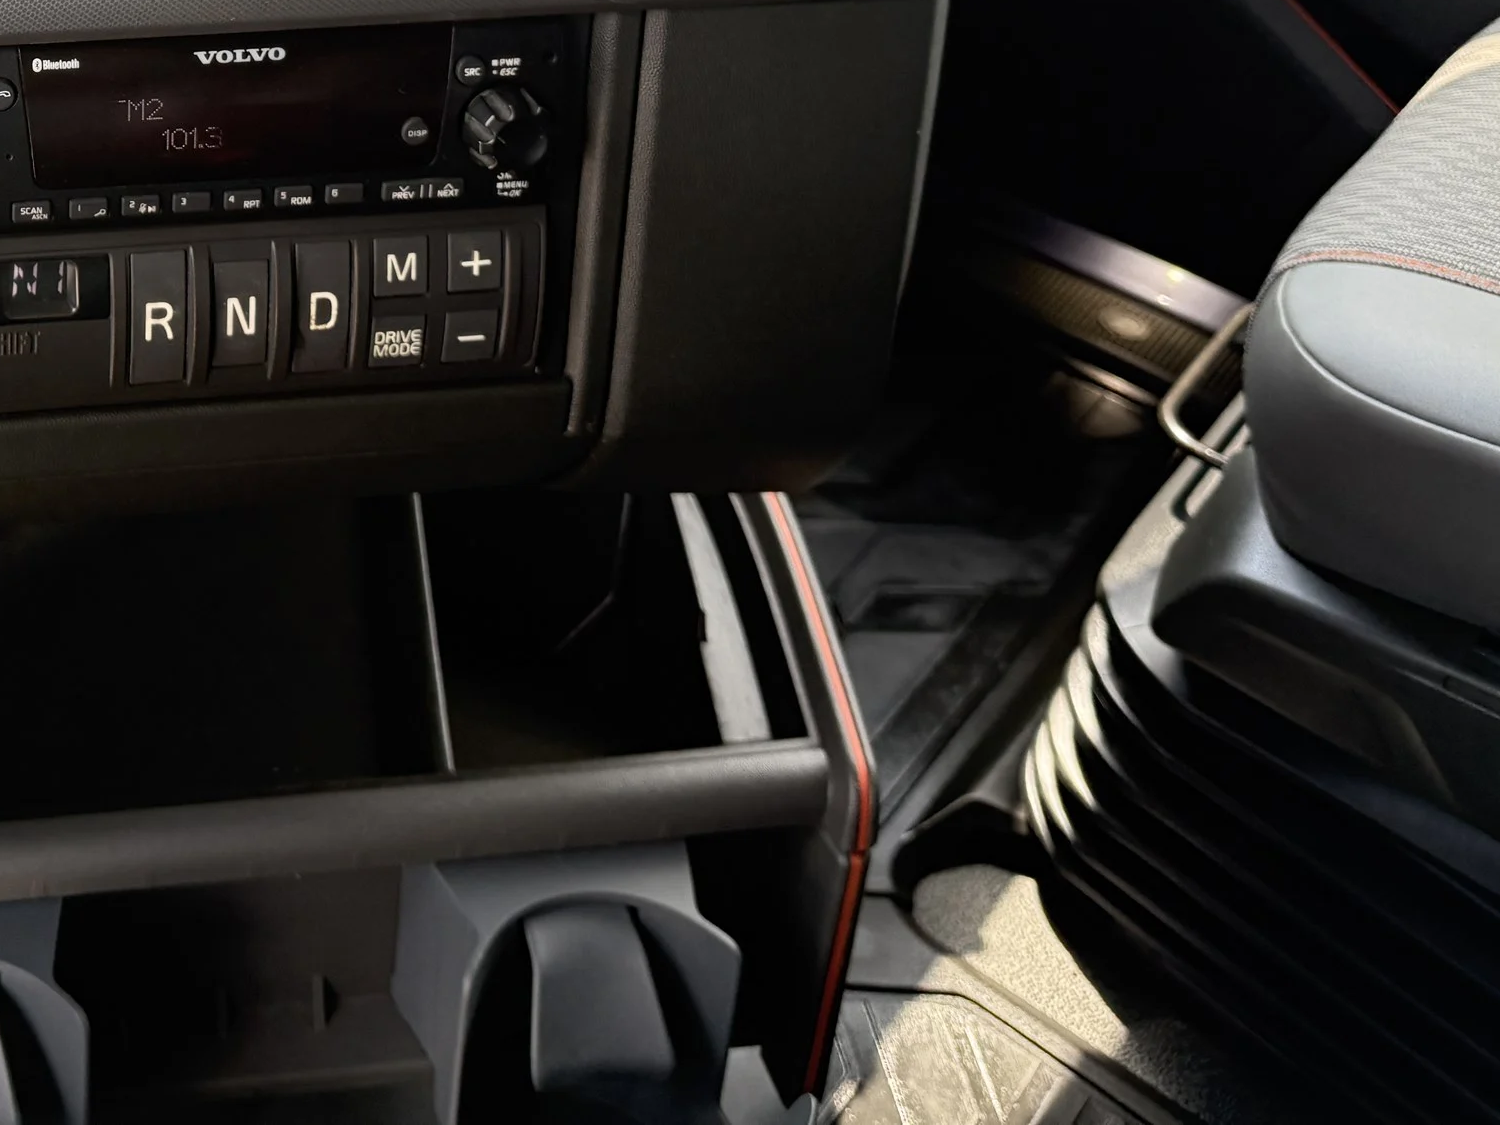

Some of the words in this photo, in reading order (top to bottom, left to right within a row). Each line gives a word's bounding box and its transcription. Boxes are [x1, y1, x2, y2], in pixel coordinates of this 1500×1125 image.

[193, 46, 287, 65] VOLVO
[43, 58, 80, 71] Bluetooth
[499, 57, 521, 66] PWR
[464, 67, 481, 77] SRC
[161, 126, 224, 151] 101.3
[408, 129, 428, 138] DISP
[280, 191, 288, 200] 5
[331, 188, 339, 198] 6
[391, 189, 415, 200] PREV
[437, 188, 459, 198] NEXT
[129, 200, 136, 209] 2
[180, 197, 187, 206] 3
[228, 194, 236, 204] 4
[243, 199, 261, 210] RPT
[20, 206, 43, 216] SCAN
[386, 252, 417, 283] M
[226, 295, 257, 338] N
[309, 291, 339, 331] D
[144, 301, 175, 342] R
[374, 328, 422, 345] DRIVE
[372, 341, 421, 358] MODE
